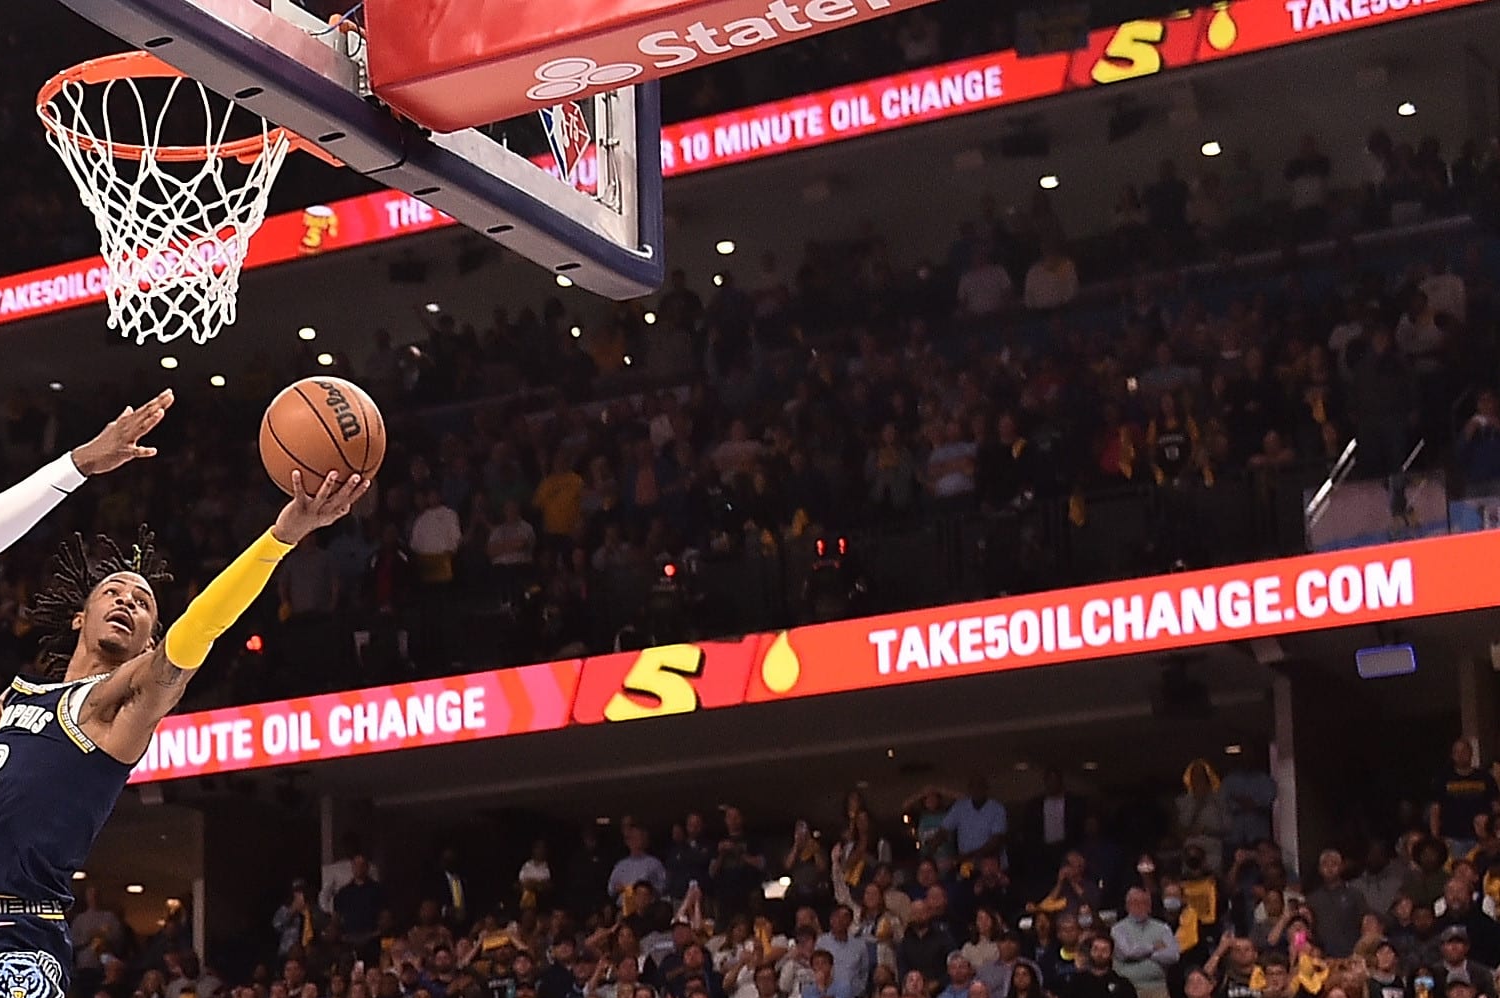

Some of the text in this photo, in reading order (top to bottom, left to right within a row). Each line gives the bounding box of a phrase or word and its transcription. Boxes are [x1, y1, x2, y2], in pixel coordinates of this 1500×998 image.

[638, 0, 858, 69] State
[1090, 20, 1164, 84] 5
[681, 131, 709, 164] 10
[714, 106, 824, 158] MINUTE
[830, 96, 875, 131] OIL
[881, 65, 1004, 120] CHANGE
[869, 557, 1414, 675] TAKE5OILCHANGE.COM
[603, 643, 702, 722] 5
[262, 711, 320, 757] OIL
[329, 686, 486, 747] CHANGE
